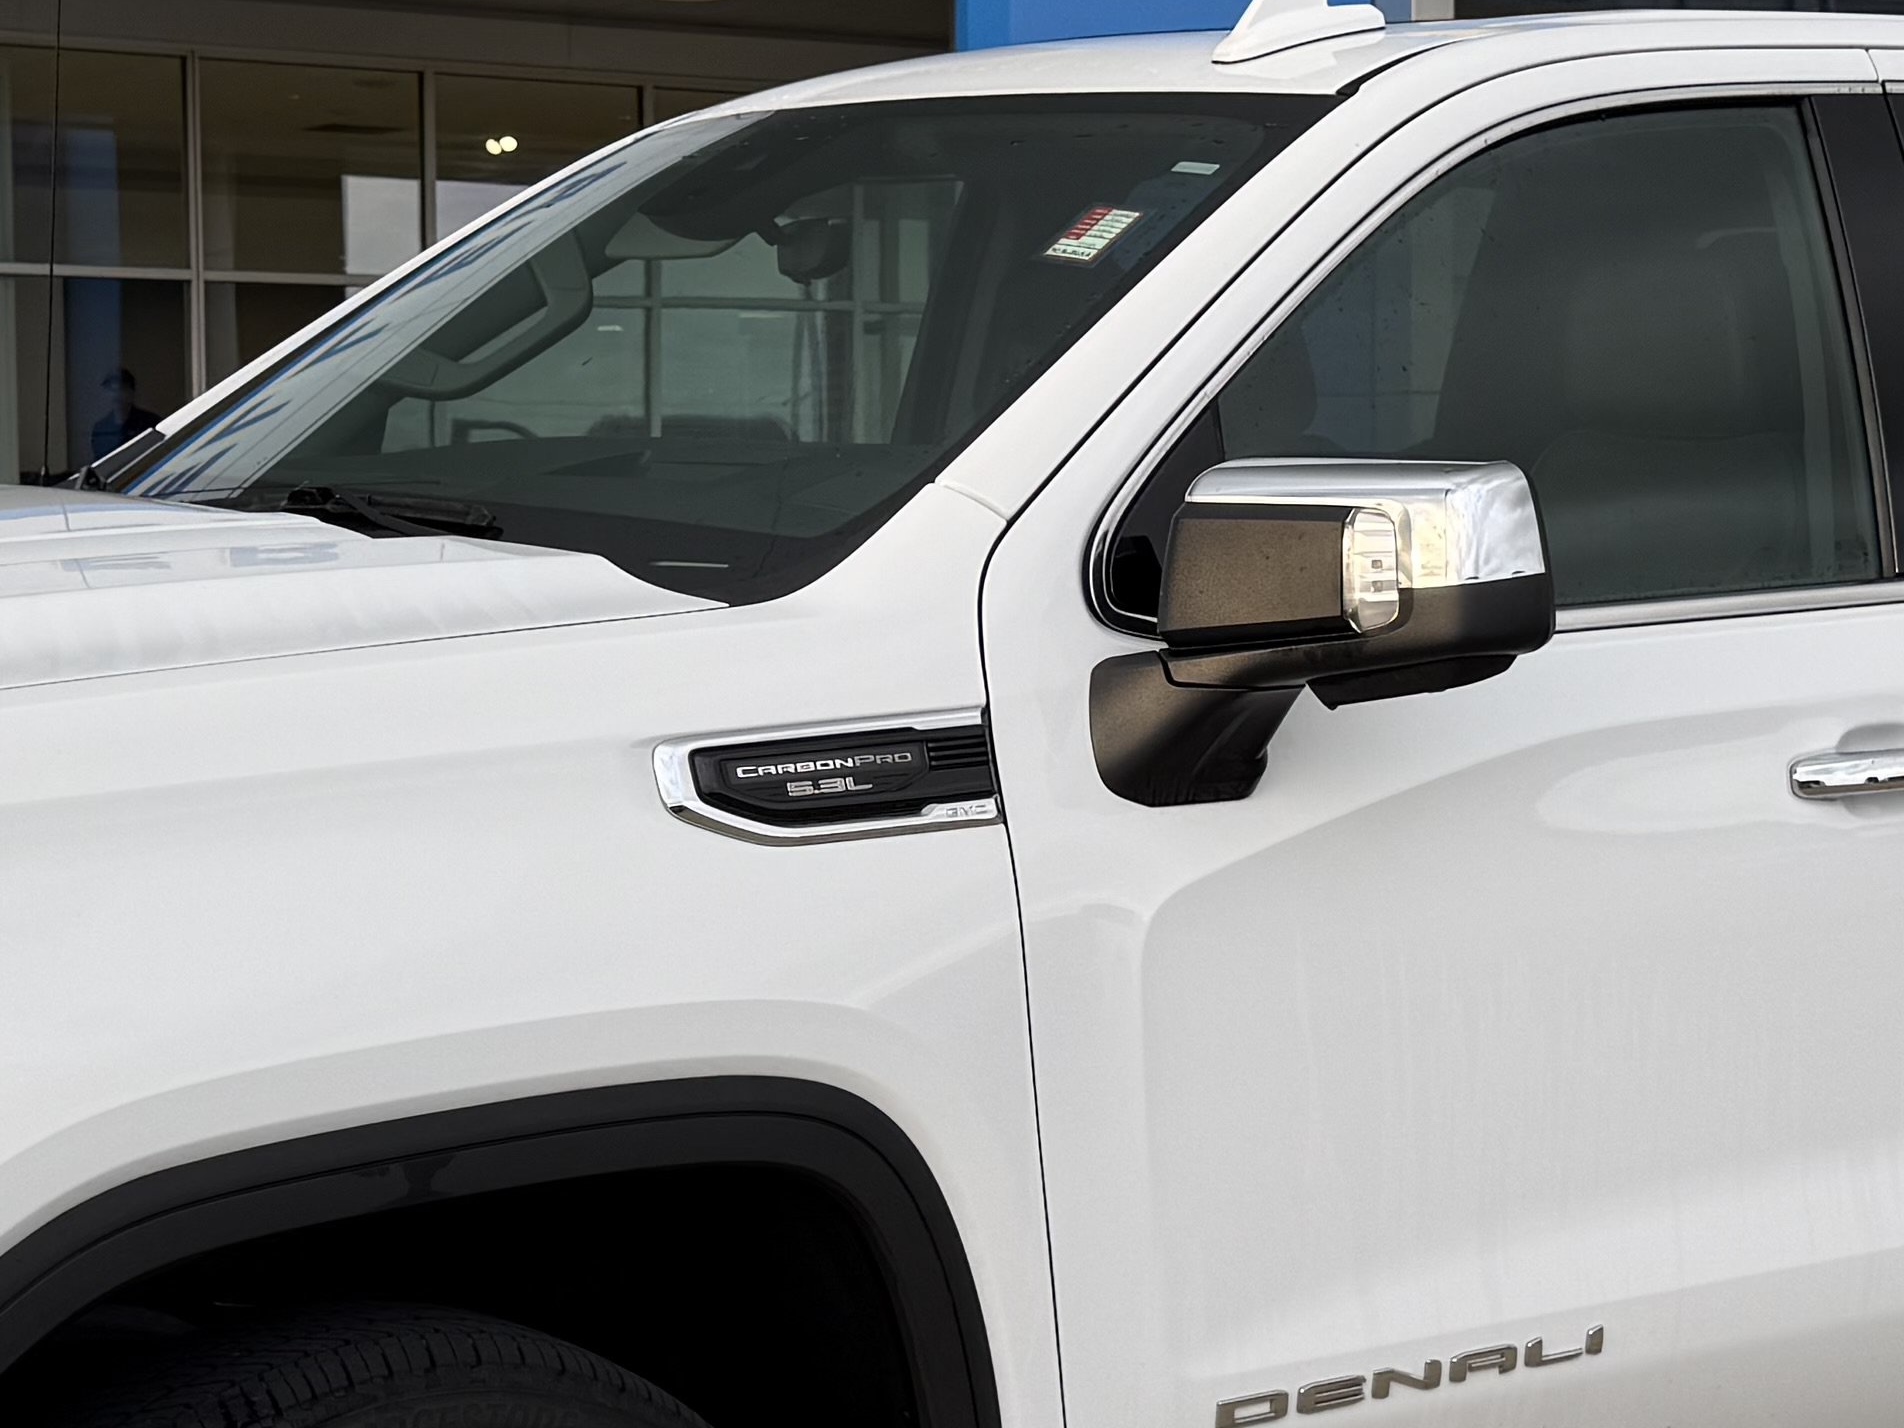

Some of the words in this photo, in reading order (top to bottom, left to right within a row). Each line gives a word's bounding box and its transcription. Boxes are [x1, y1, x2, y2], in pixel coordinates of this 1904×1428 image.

[735, 752, 912, 779] CARBONPRO
[786, 776, 873, 797] 5.3L
[945, 804, 988, 818] GMC
